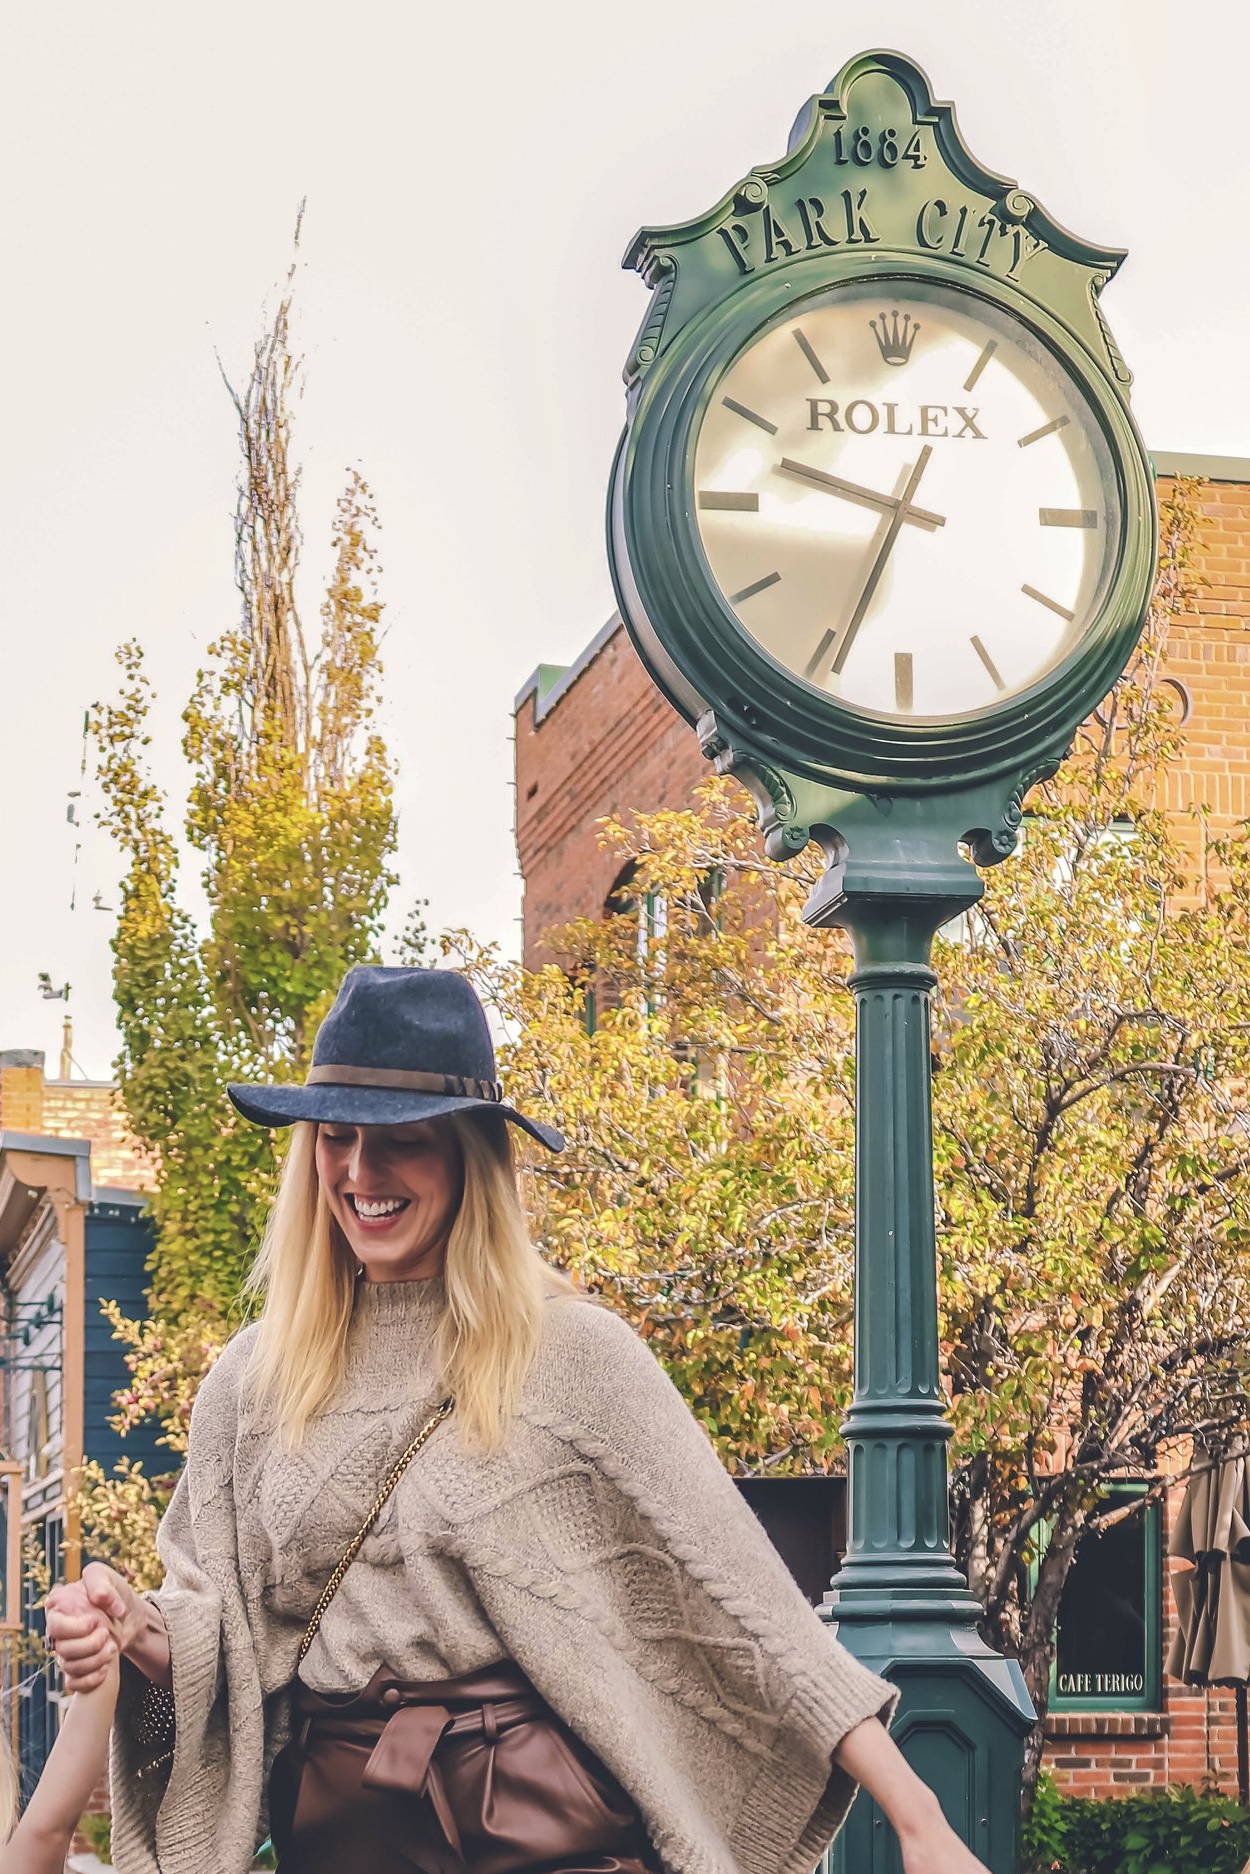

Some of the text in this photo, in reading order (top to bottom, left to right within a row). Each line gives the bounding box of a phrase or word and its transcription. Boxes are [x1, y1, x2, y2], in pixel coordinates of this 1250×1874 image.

[832, 124, 928, 170] 1884
[716, 187, 1049, 282] PARK CITY
[805, 398, 989, 440] ROLEX
[1059, 1673, 1143, 1692] CAFE TERIGO
